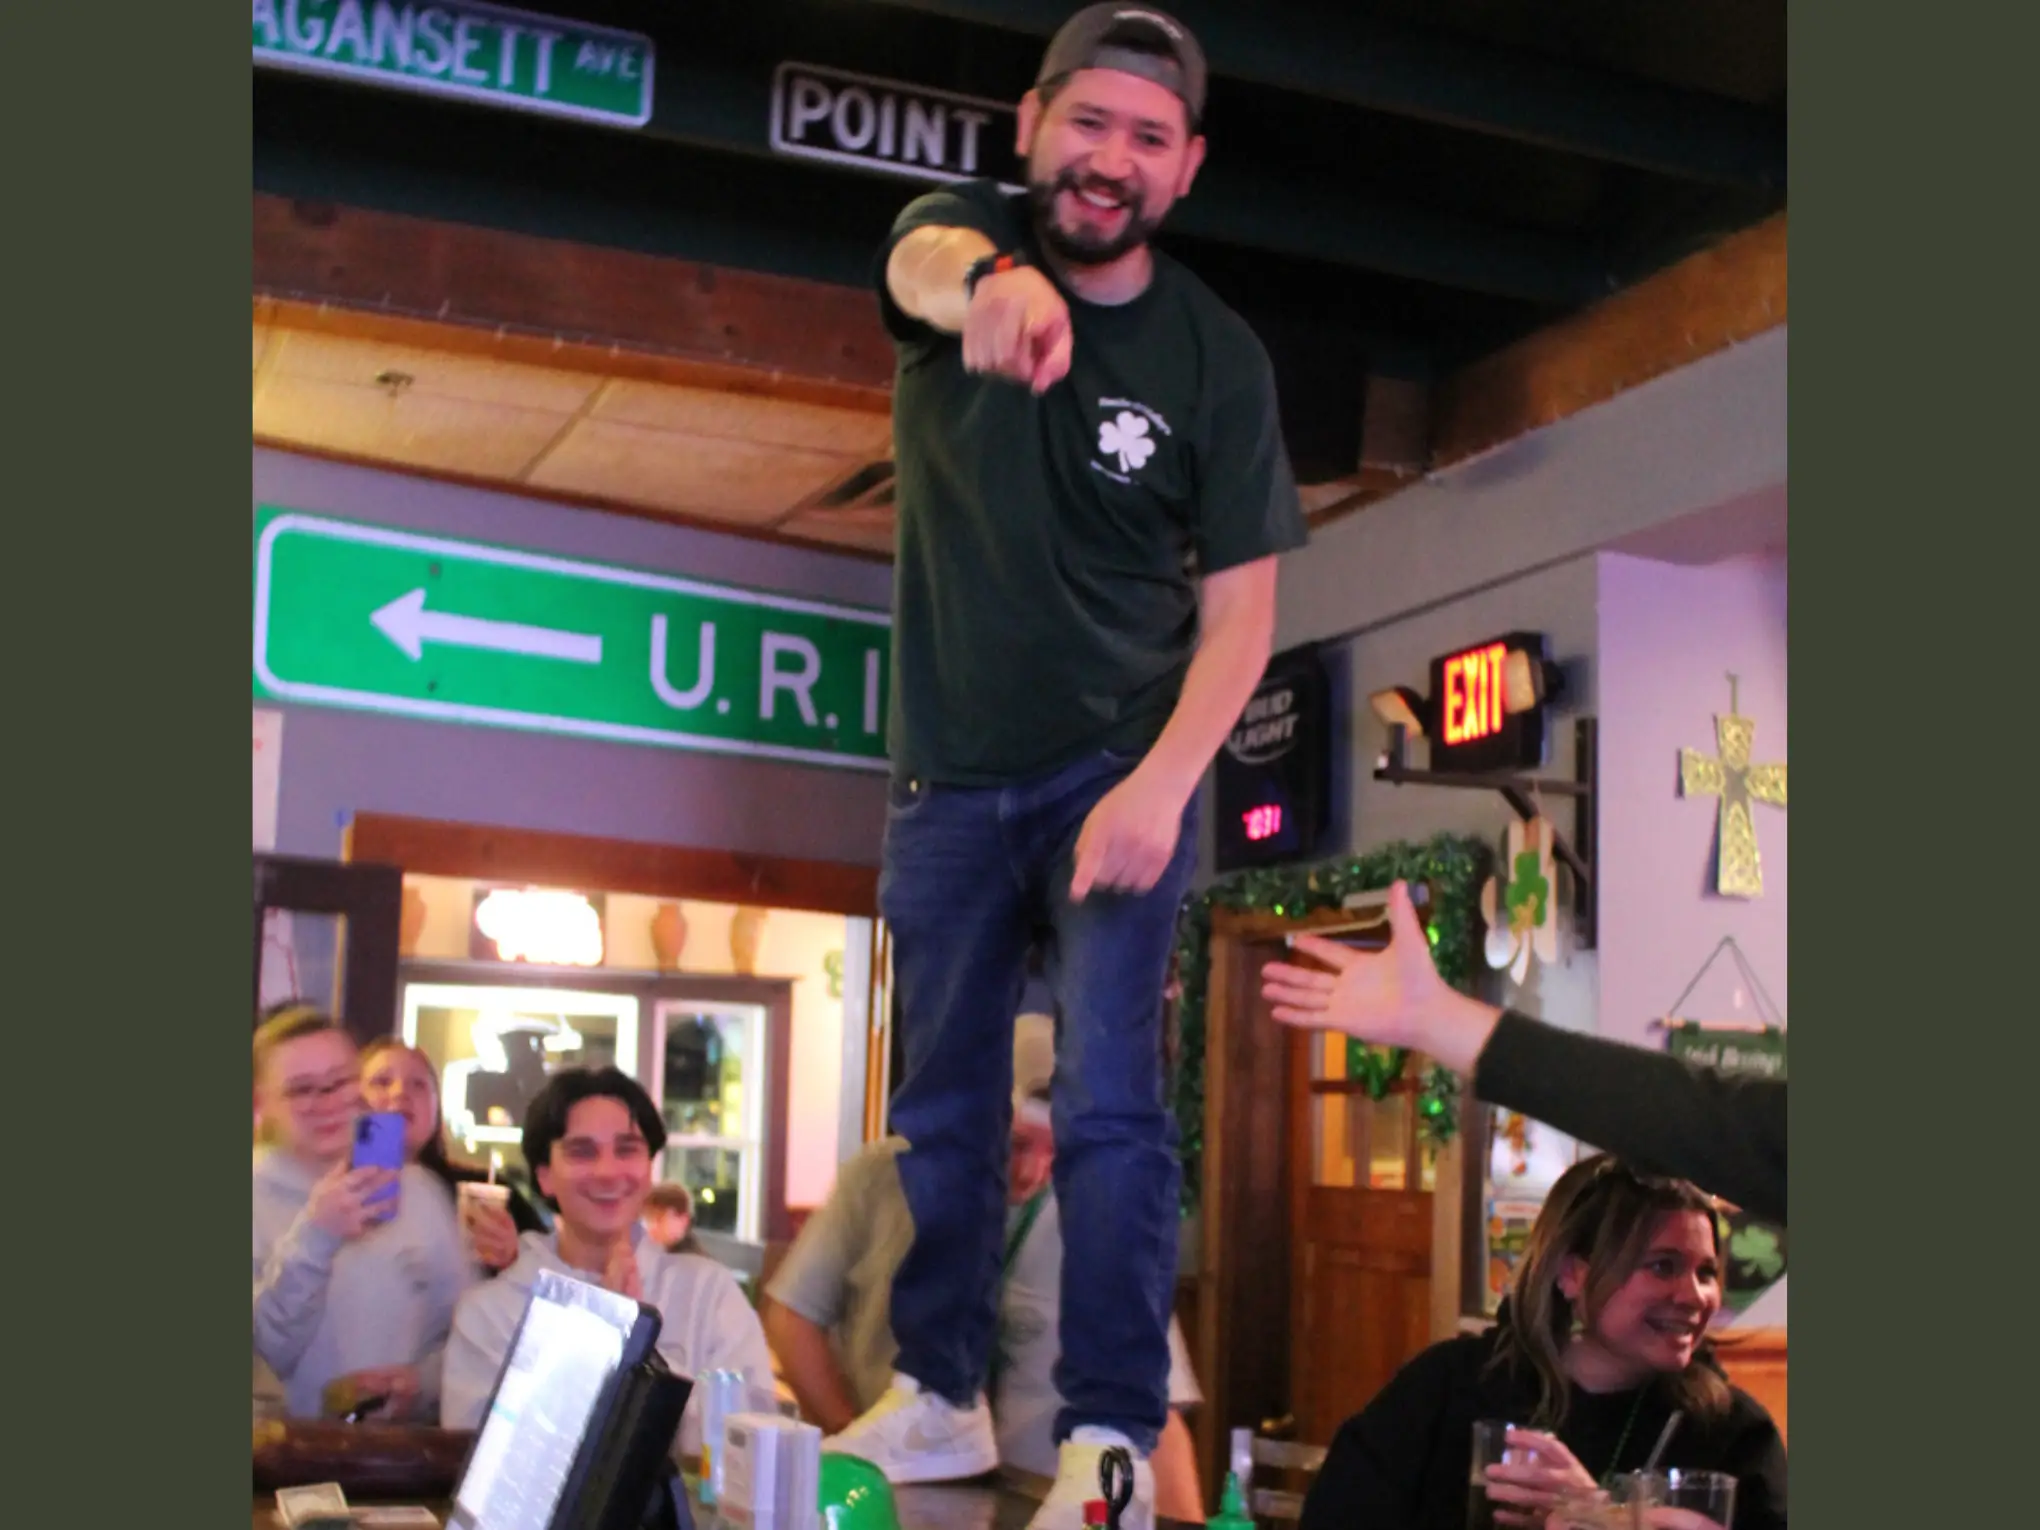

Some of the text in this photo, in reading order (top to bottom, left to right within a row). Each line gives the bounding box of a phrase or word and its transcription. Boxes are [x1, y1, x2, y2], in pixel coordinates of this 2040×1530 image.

[574, 39, 641, 79] AVE
[790, 76, 992, 172] POINT
[1245, 688, 1294, 724] UD
[1443, 641, 1507, 747] EXIT
